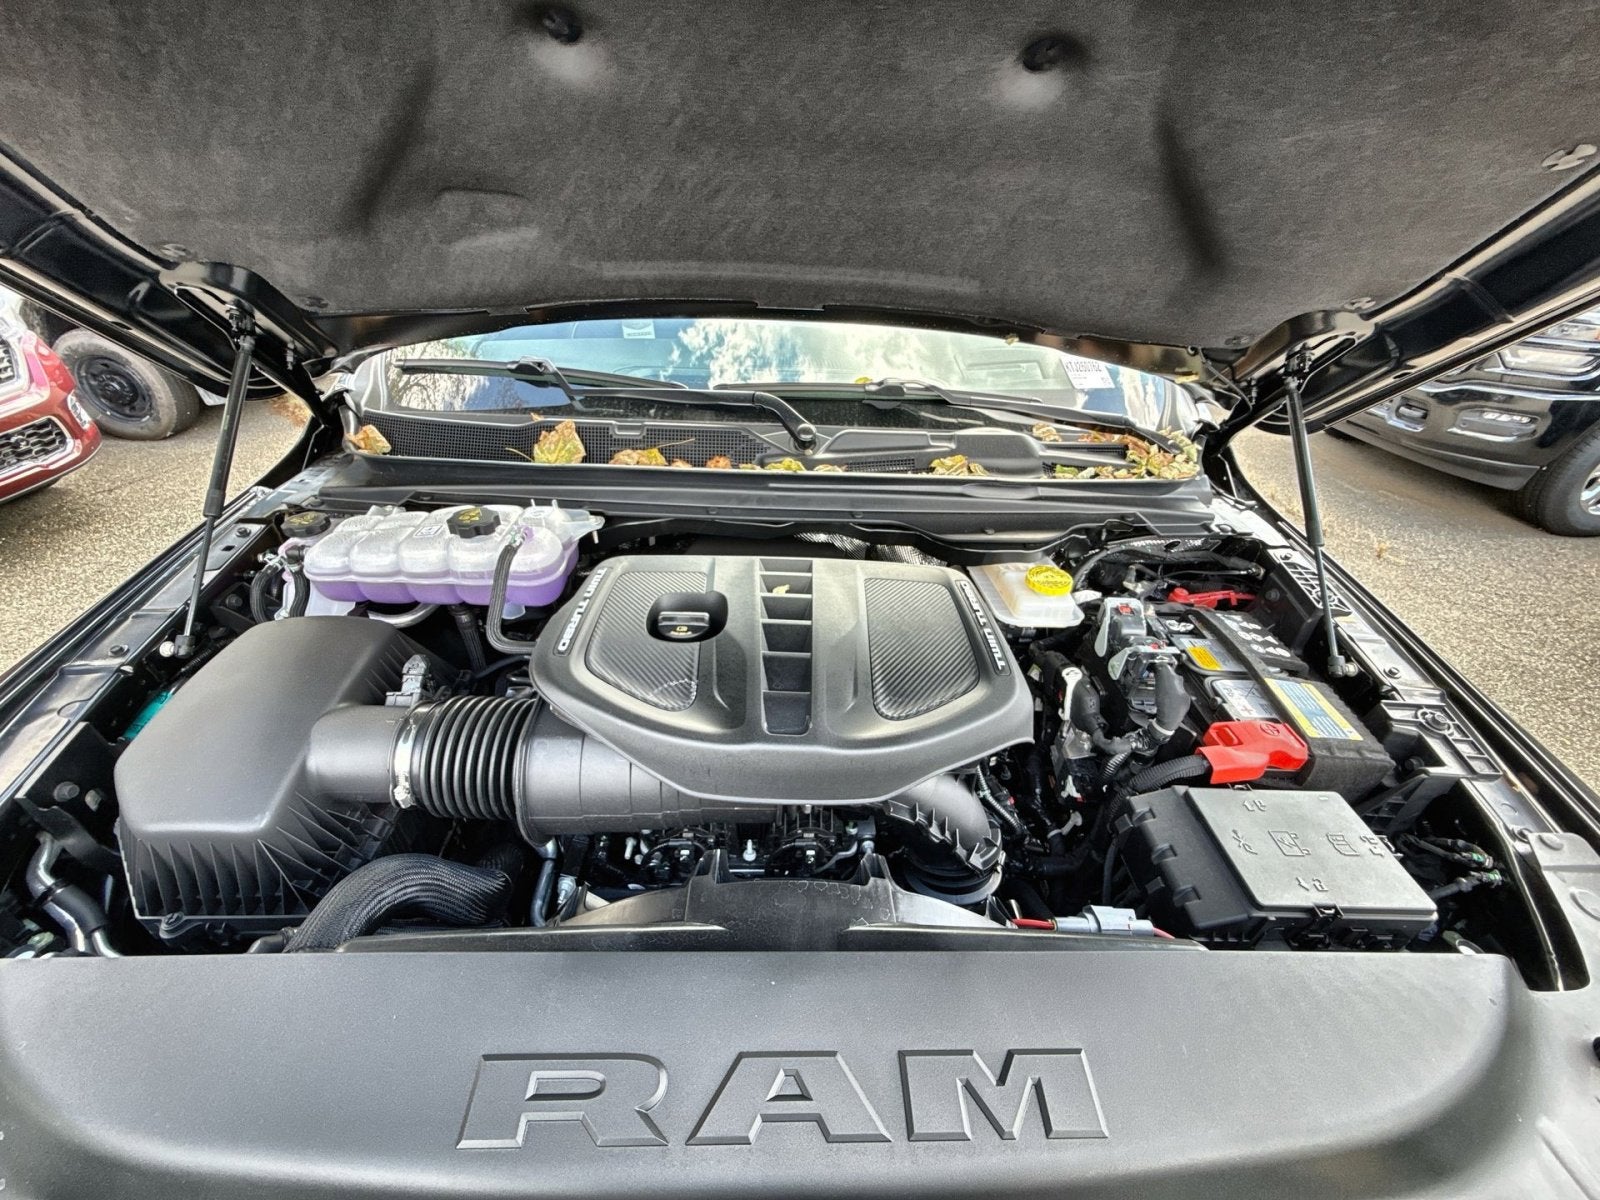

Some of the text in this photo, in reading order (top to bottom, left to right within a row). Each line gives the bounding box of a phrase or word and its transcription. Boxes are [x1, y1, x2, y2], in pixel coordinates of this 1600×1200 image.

[557, 567, 607, 651] TWIN TURBO
[960, 580, 1006, 670] TWIN TURBO
[456, 1047, 1109, 1149] RAM
